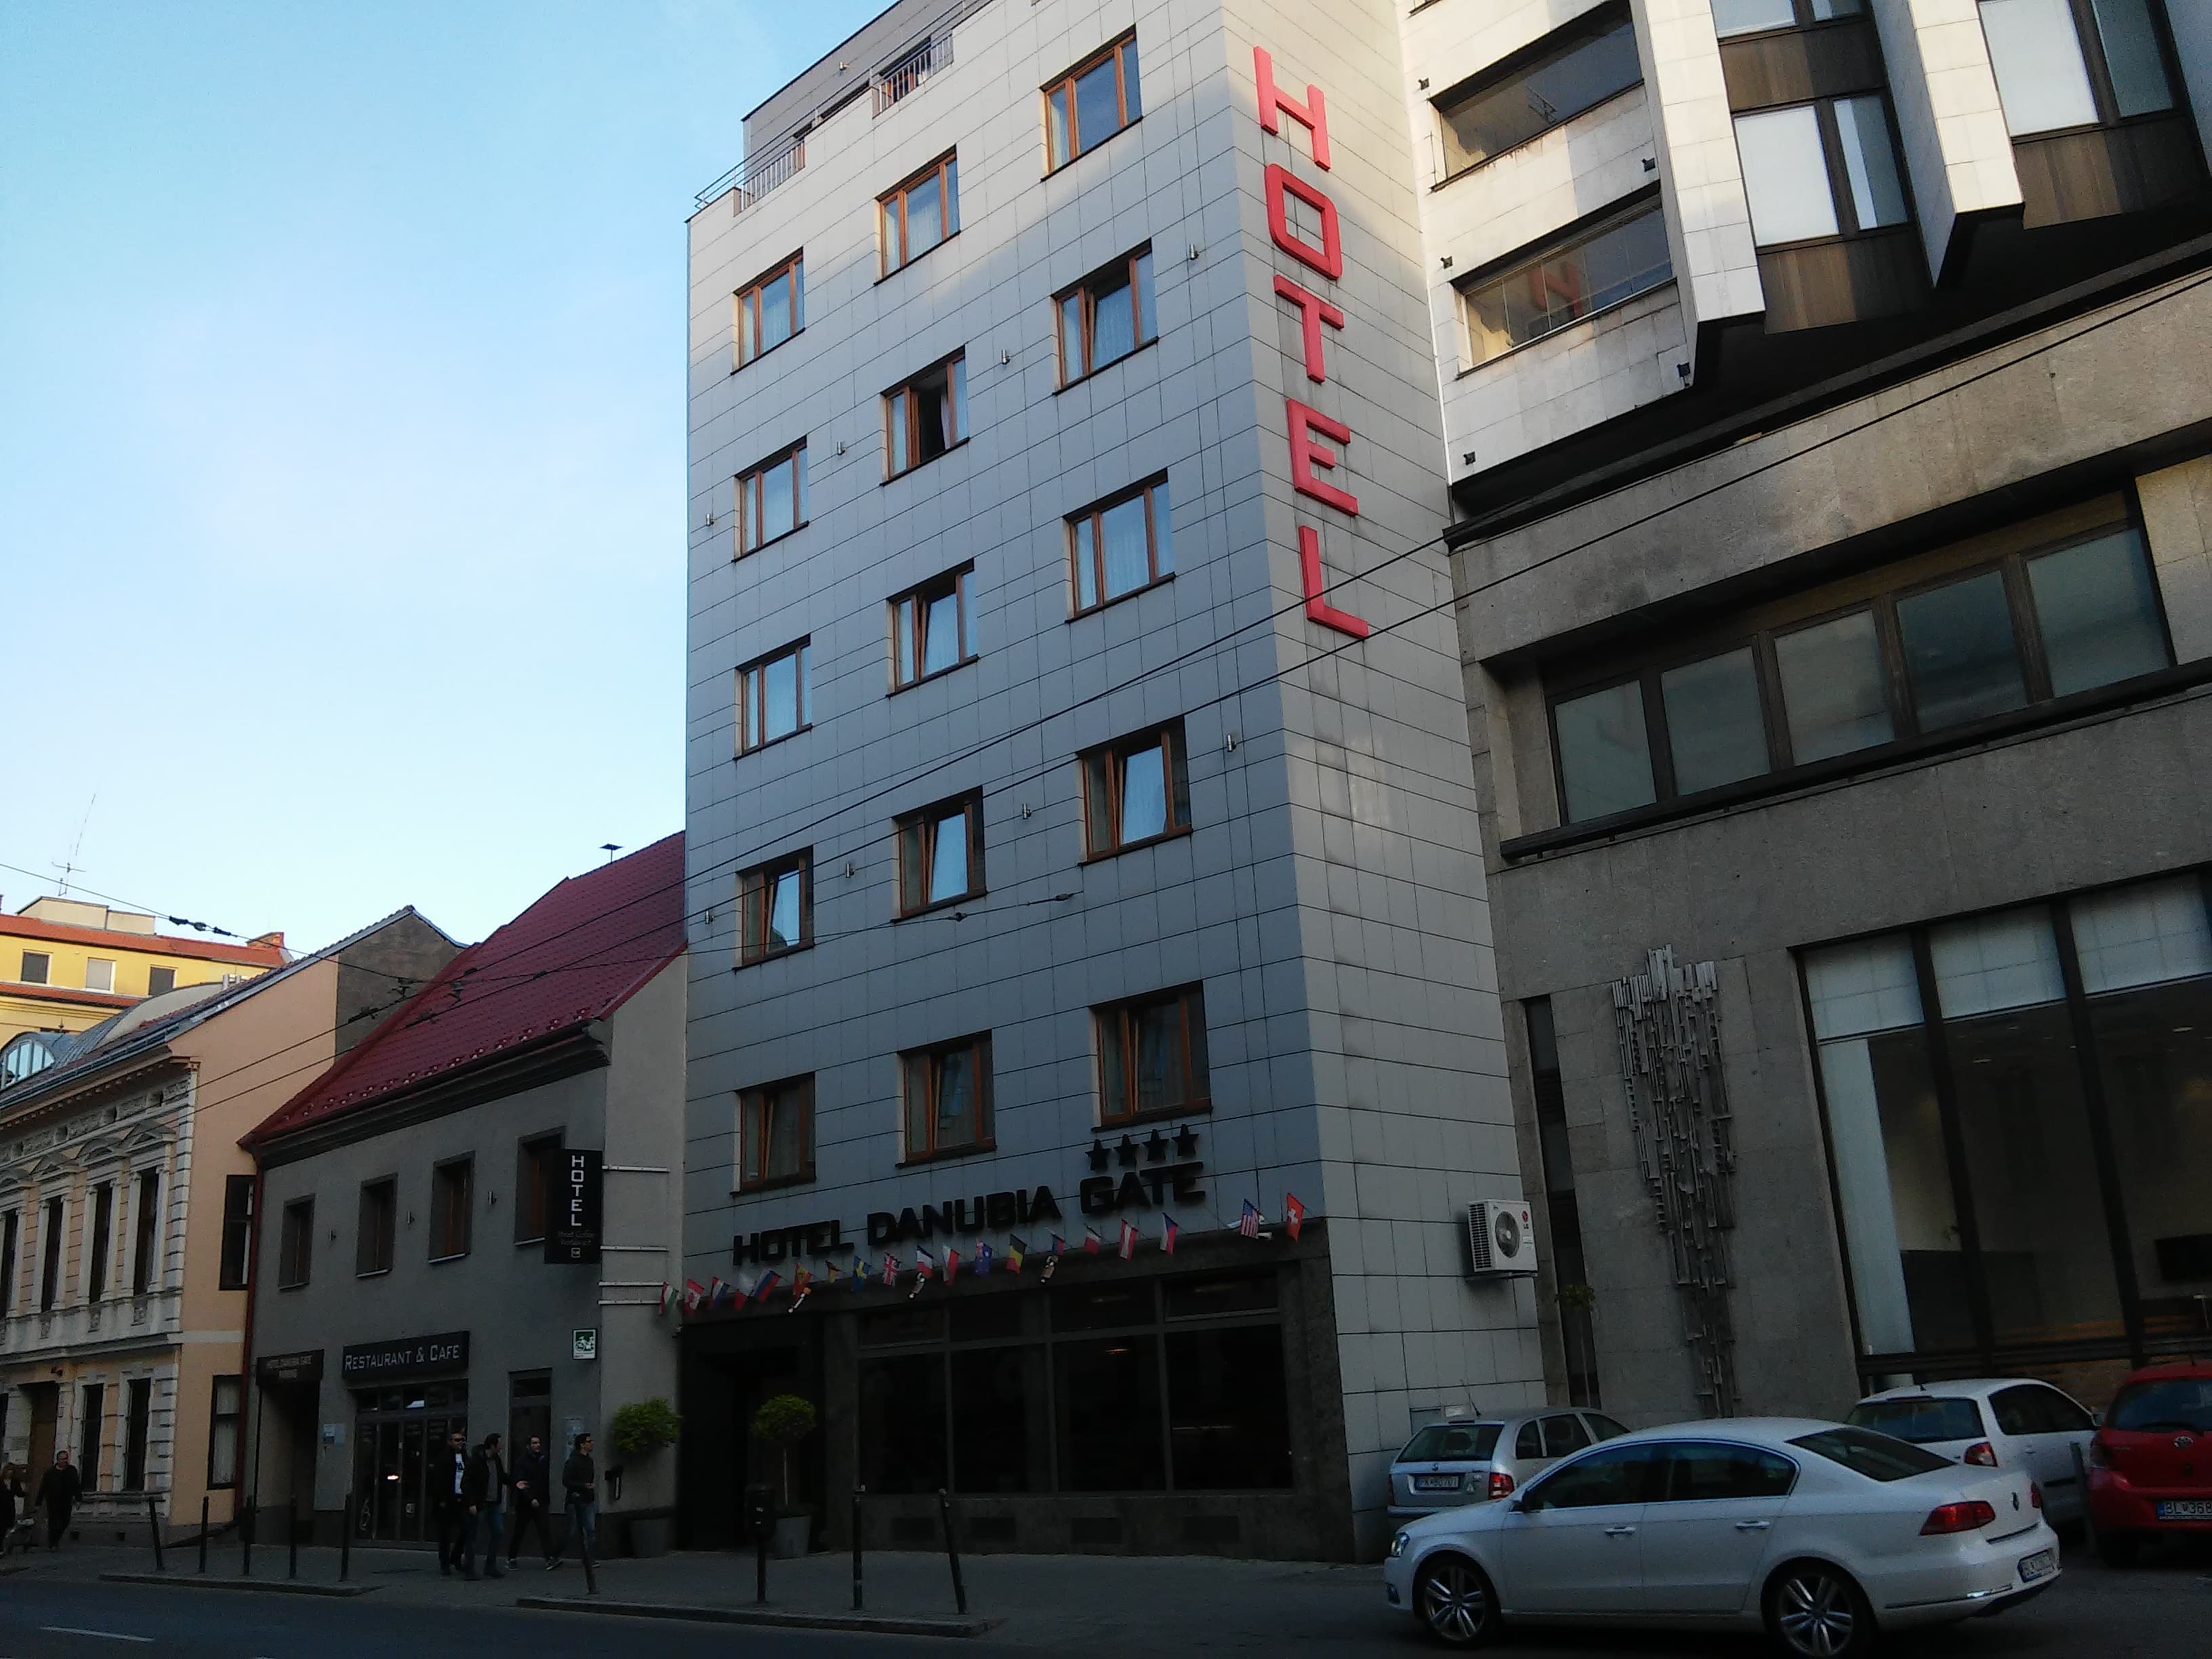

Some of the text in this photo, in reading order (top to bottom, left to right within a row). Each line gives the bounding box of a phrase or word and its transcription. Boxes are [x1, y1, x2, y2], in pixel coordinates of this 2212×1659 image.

[1253, 45, 1369, 640] HOTEL
[571, 1154, 585, 1227] HOTEL
[733, 1161, 1206, 1265] HOTEL DANUBIA GATE
[344, 1344, 460, 1371] RESTAURANT & CAFE
